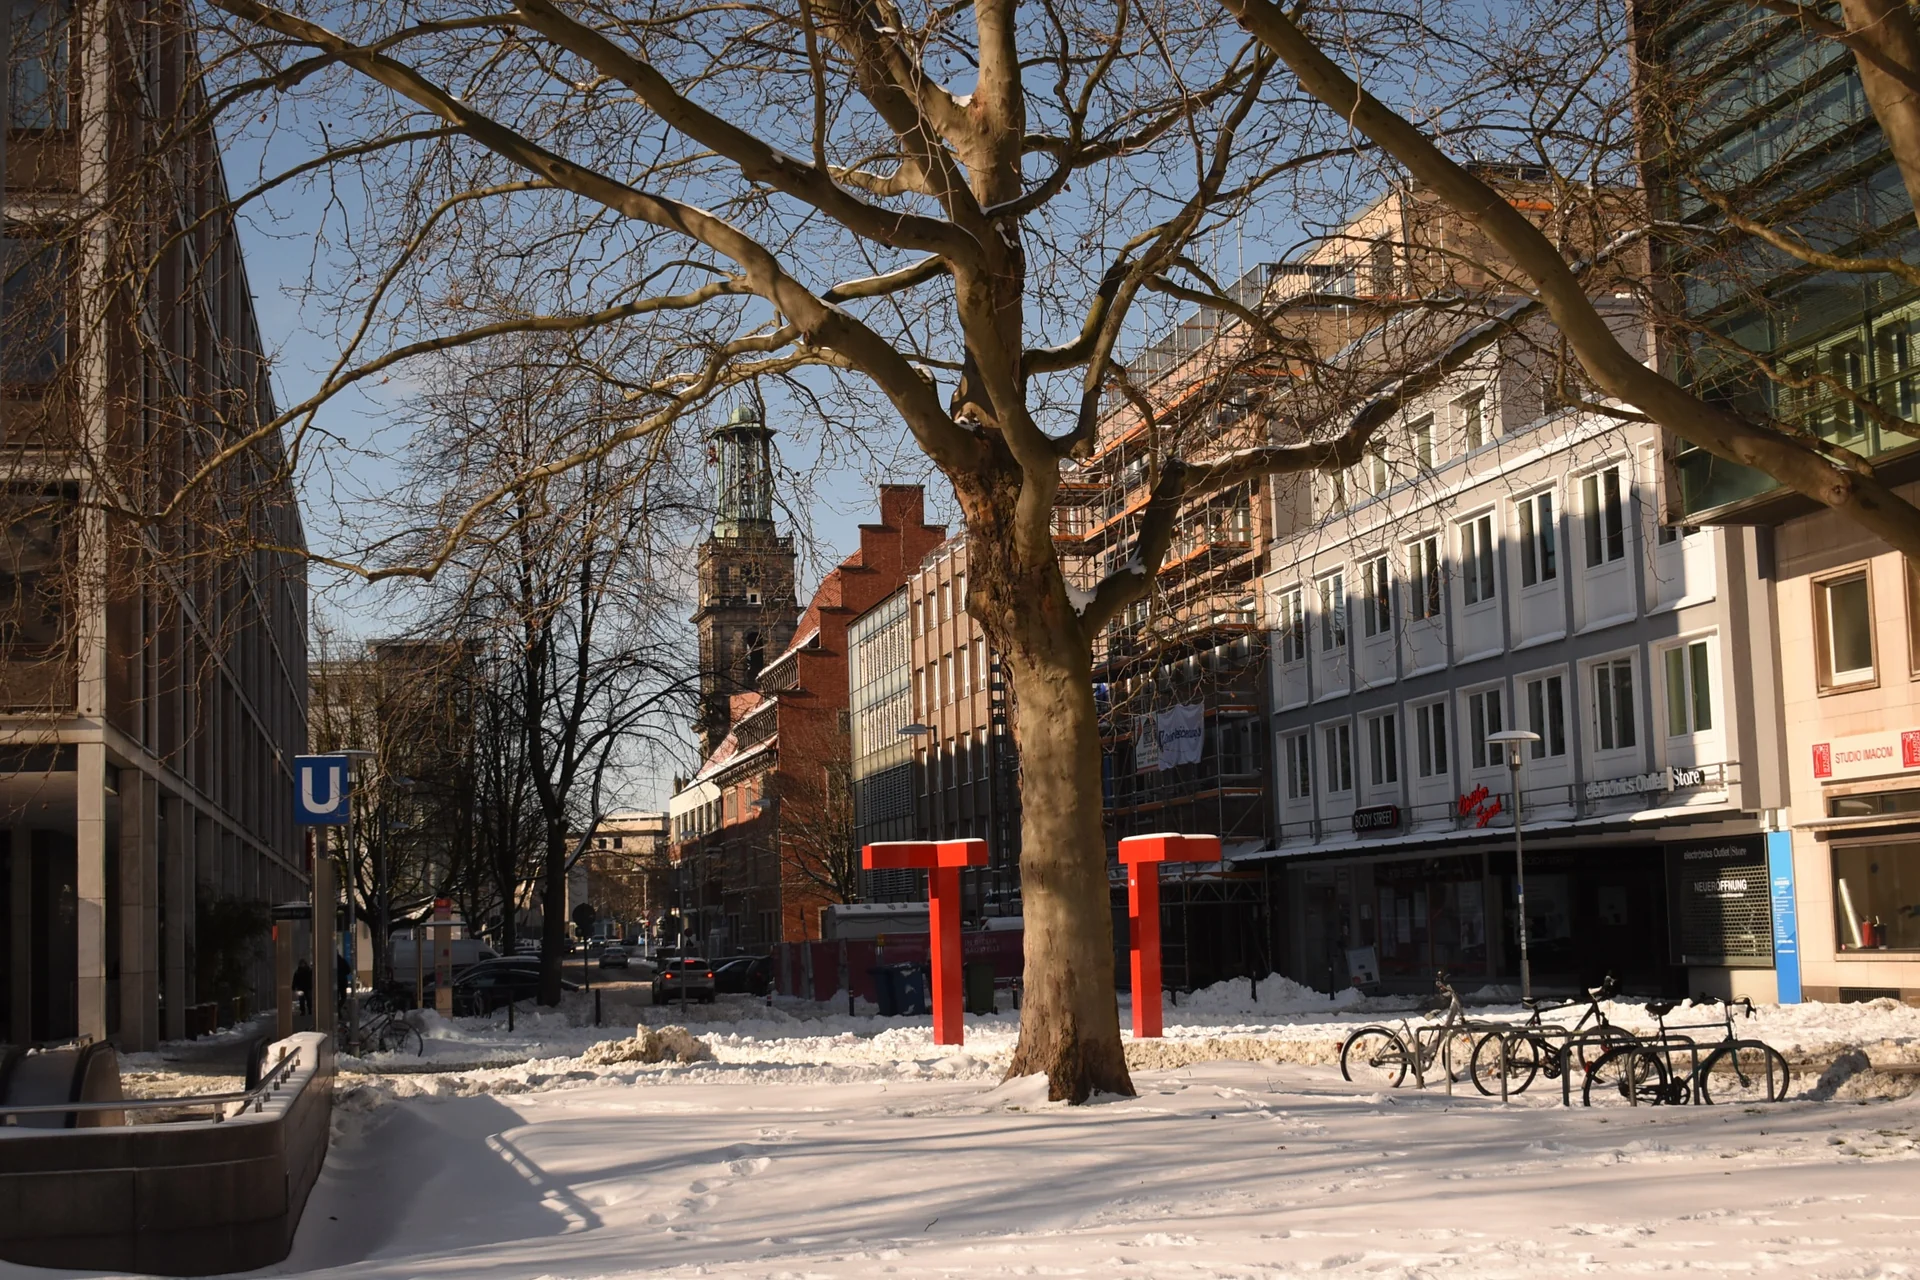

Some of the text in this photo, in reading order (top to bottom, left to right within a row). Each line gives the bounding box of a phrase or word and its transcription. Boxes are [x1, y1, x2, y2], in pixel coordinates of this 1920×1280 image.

[1835, 750, 1861, 764] STUDIO
[1863, 746, 1894, 760] IMACOM
[302, 767, 340, 814] U
[1586, 777, 1635, 799] electronics
[1673, 766, 1701, 787] Store
[1355, 810, 1393, 828] BODY STREET
[1684, 849, 1713, 860] electronics
[1694, 879, 1748, 892] NEUERÖFFNUNG
